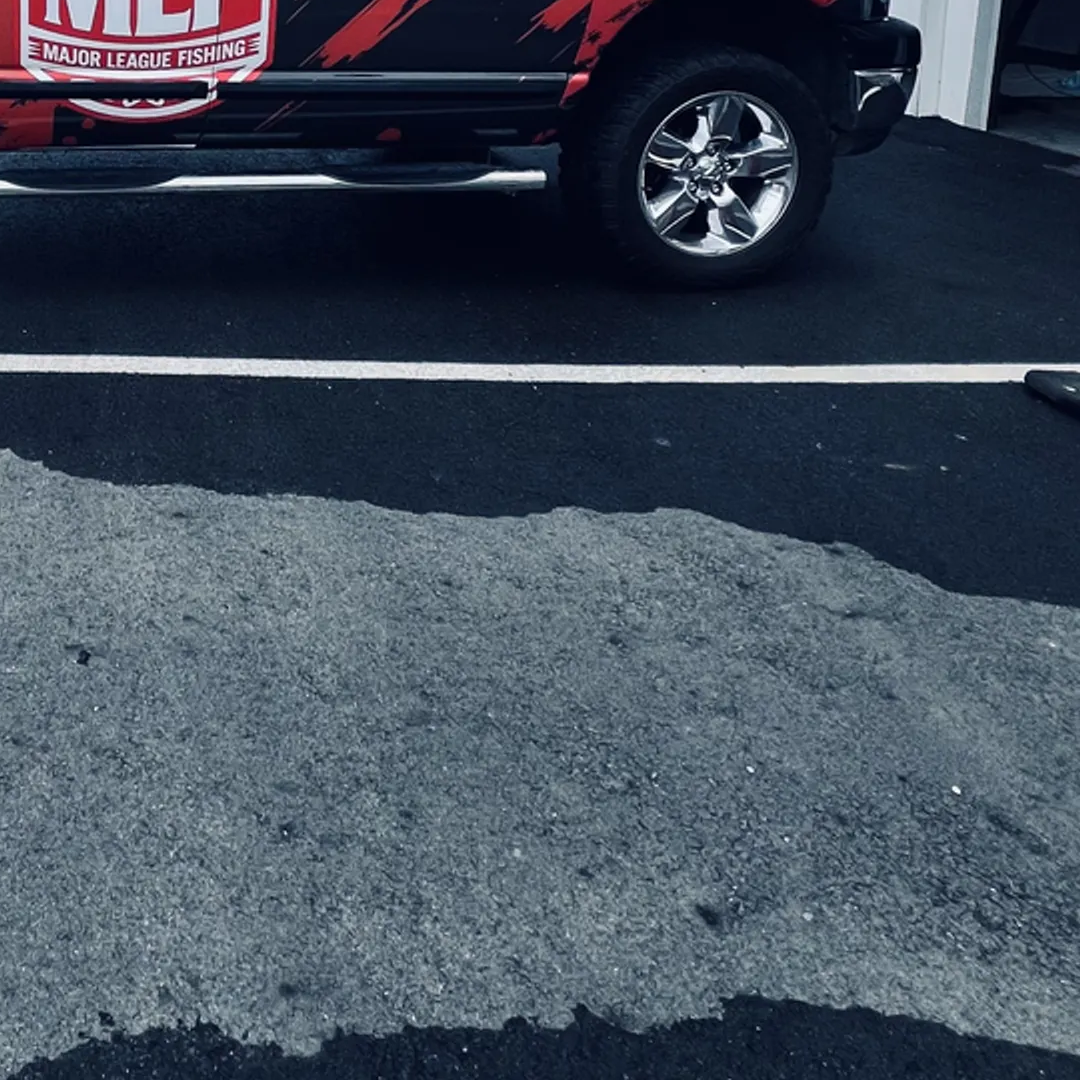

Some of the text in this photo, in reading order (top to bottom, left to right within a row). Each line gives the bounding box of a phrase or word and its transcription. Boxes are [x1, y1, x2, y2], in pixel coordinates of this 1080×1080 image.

[42, 39, 246, 69] MAJOR LEAGUE FISHING
